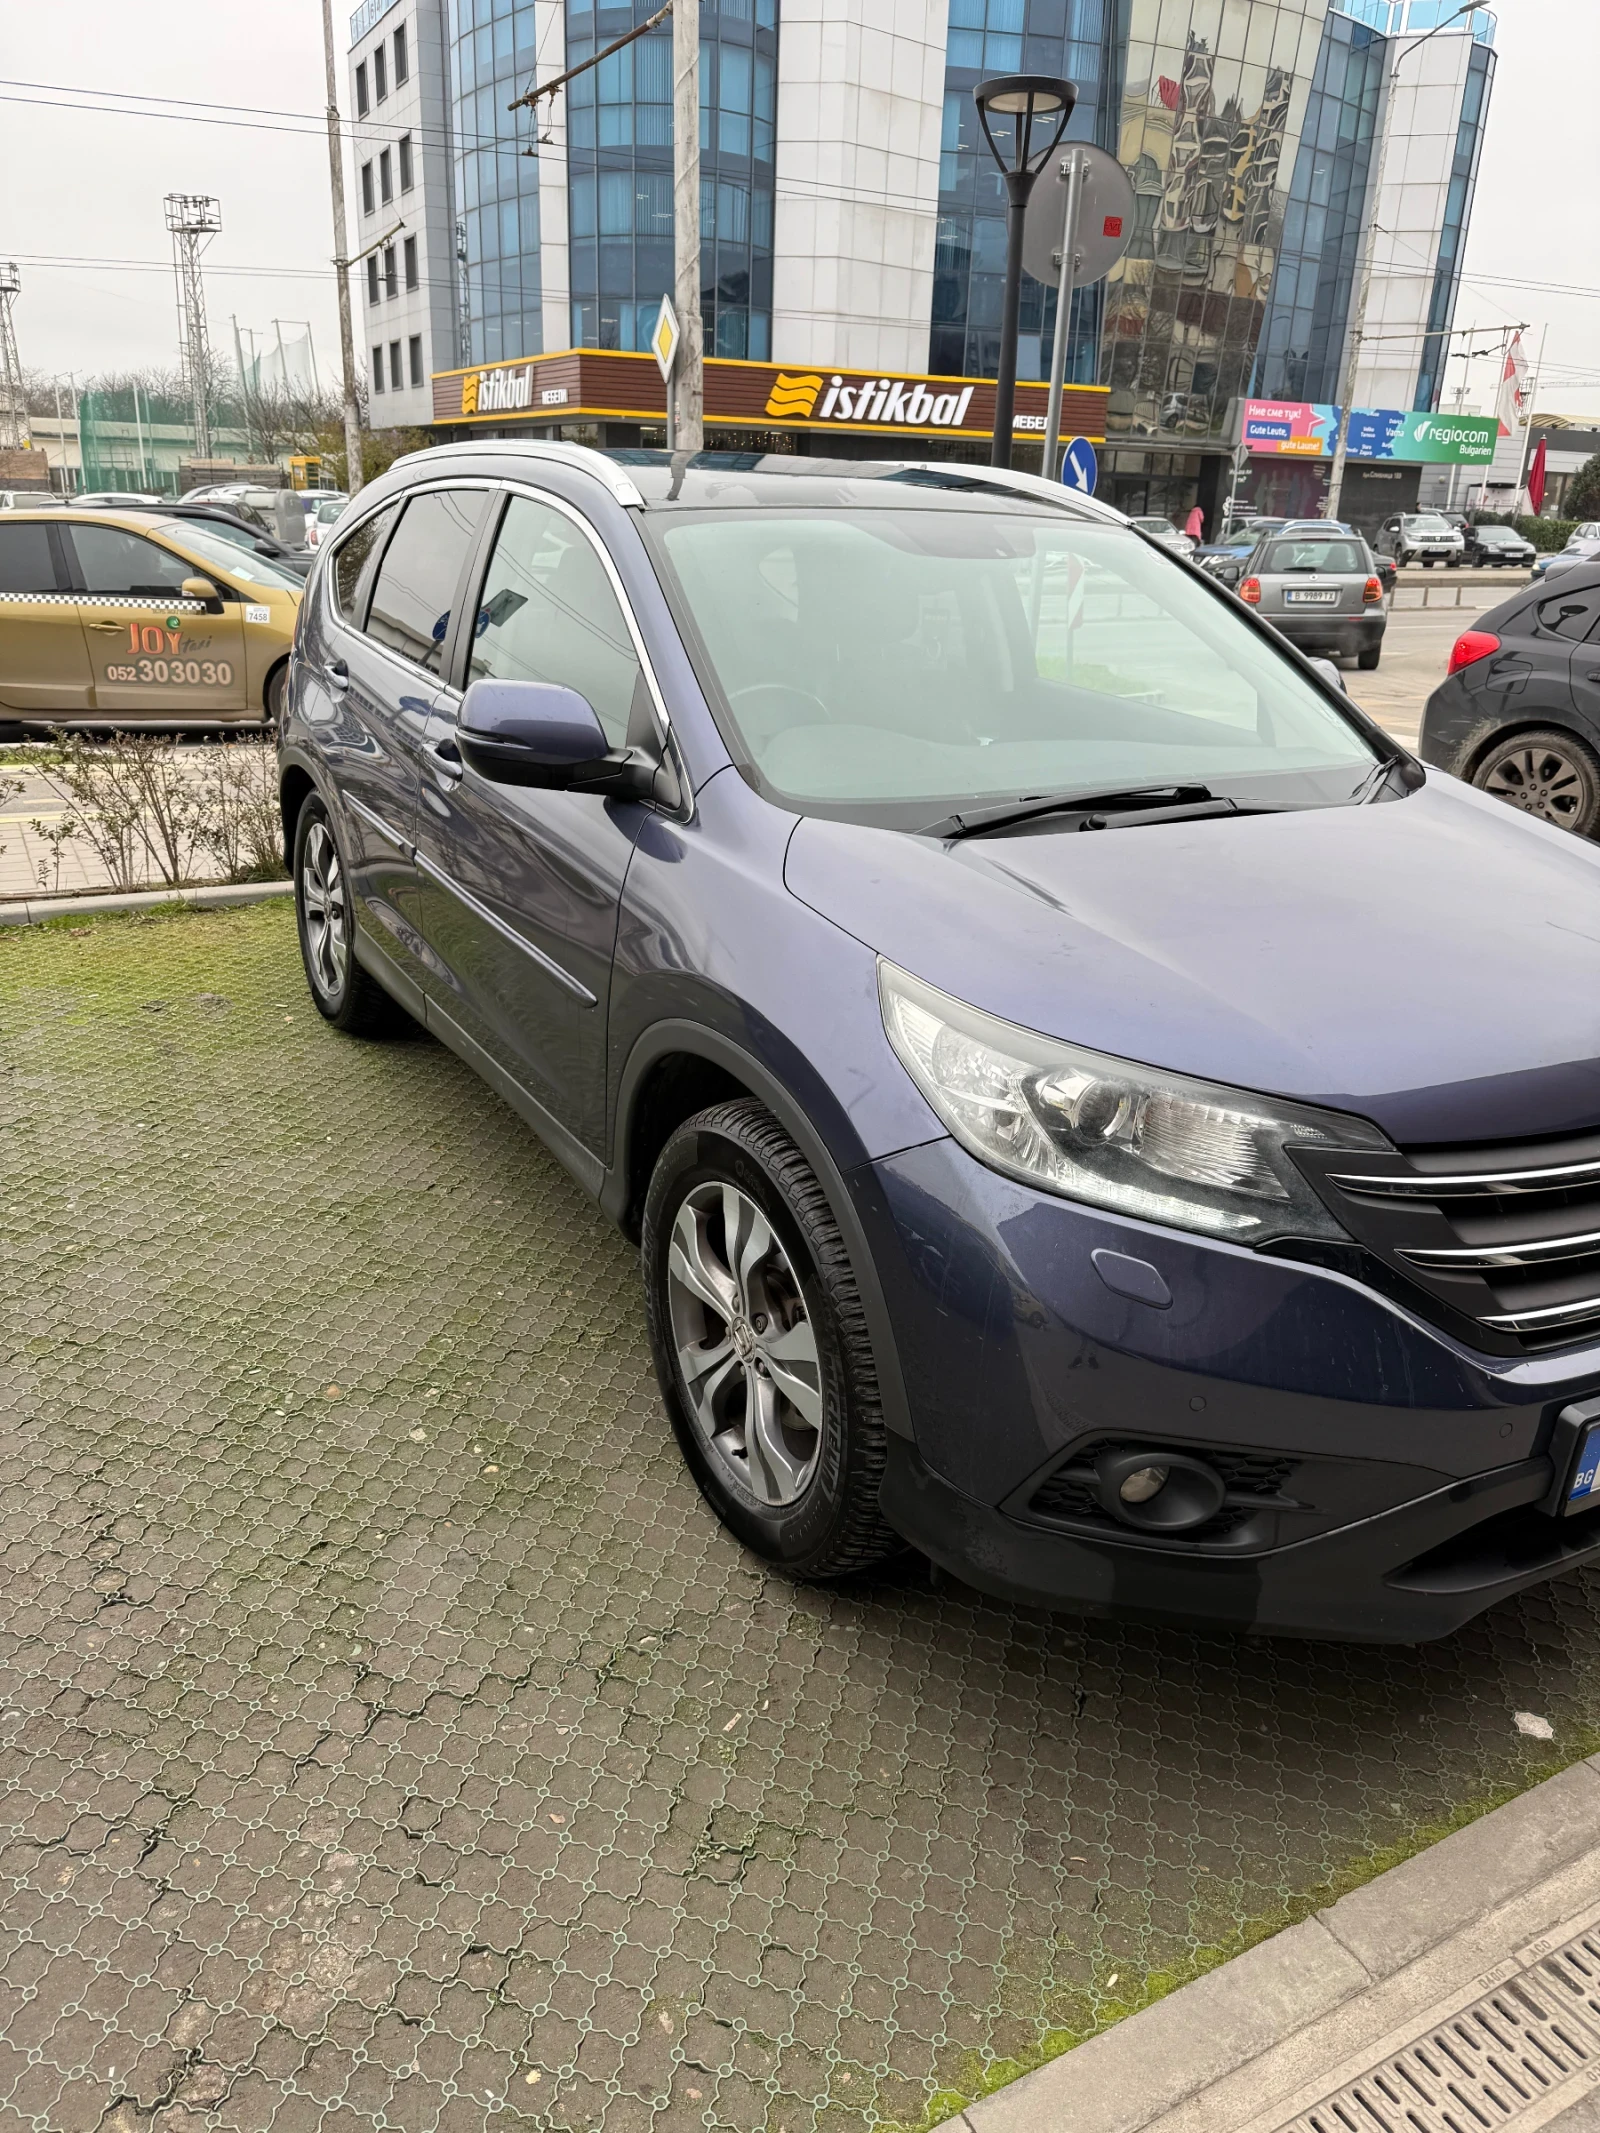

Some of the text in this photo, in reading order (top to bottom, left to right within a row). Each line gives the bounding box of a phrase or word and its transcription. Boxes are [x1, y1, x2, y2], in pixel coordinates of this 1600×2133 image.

[478, 365, 534, 411] istikbal
[542, 389, 569, 405] МЕБЕЛИ
[819, 375, 975, 426] istikbal
[1248, 405, 1266, 417] Ние
[1267, 408, 1283, 418] сме
[1250, 425, 1266, 435] Gute
[1386, 428, 1405, 437] Varna
[1428, 425, 1489, 444] regiocom
[1281, 441, 1296, 451] gute
[1459, 444, 1492, 456] Bulgarien
[249, 613, 268, 621] 7458
[126, 623, 212, 655] JOY taxi
[107, 666, 137, 682] 052
[1573, 1469, 1594, 1489] BG
[1528, 1940, 1551, 1962] ACO
[1477, 1968, 1506, 1990] D400
